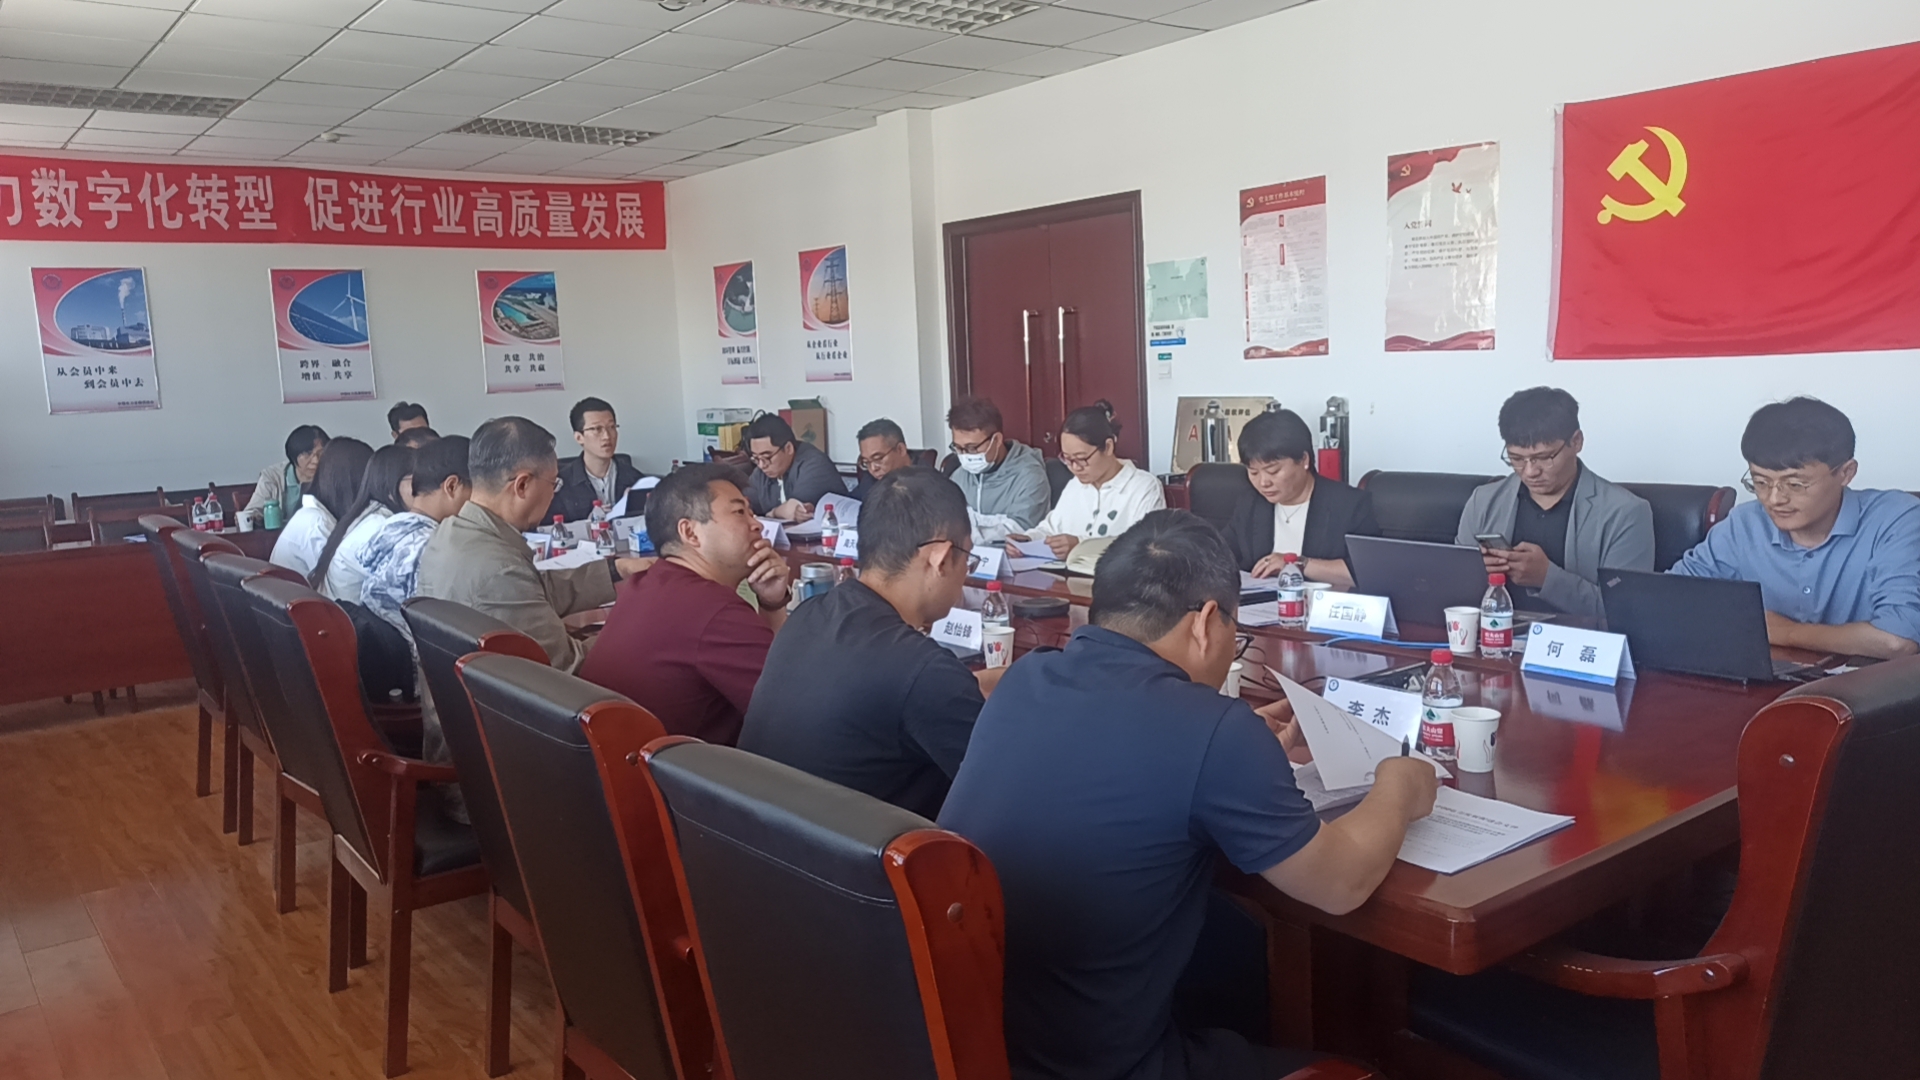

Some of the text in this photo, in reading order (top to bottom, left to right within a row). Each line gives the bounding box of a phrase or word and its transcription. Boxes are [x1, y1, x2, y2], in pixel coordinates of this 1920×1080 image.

[303, 176, 646, 240] 促进行业高质量发展
[57, 365, 118, 377] 从会员中来
[84, 377, 144, 389] 到会员中去
